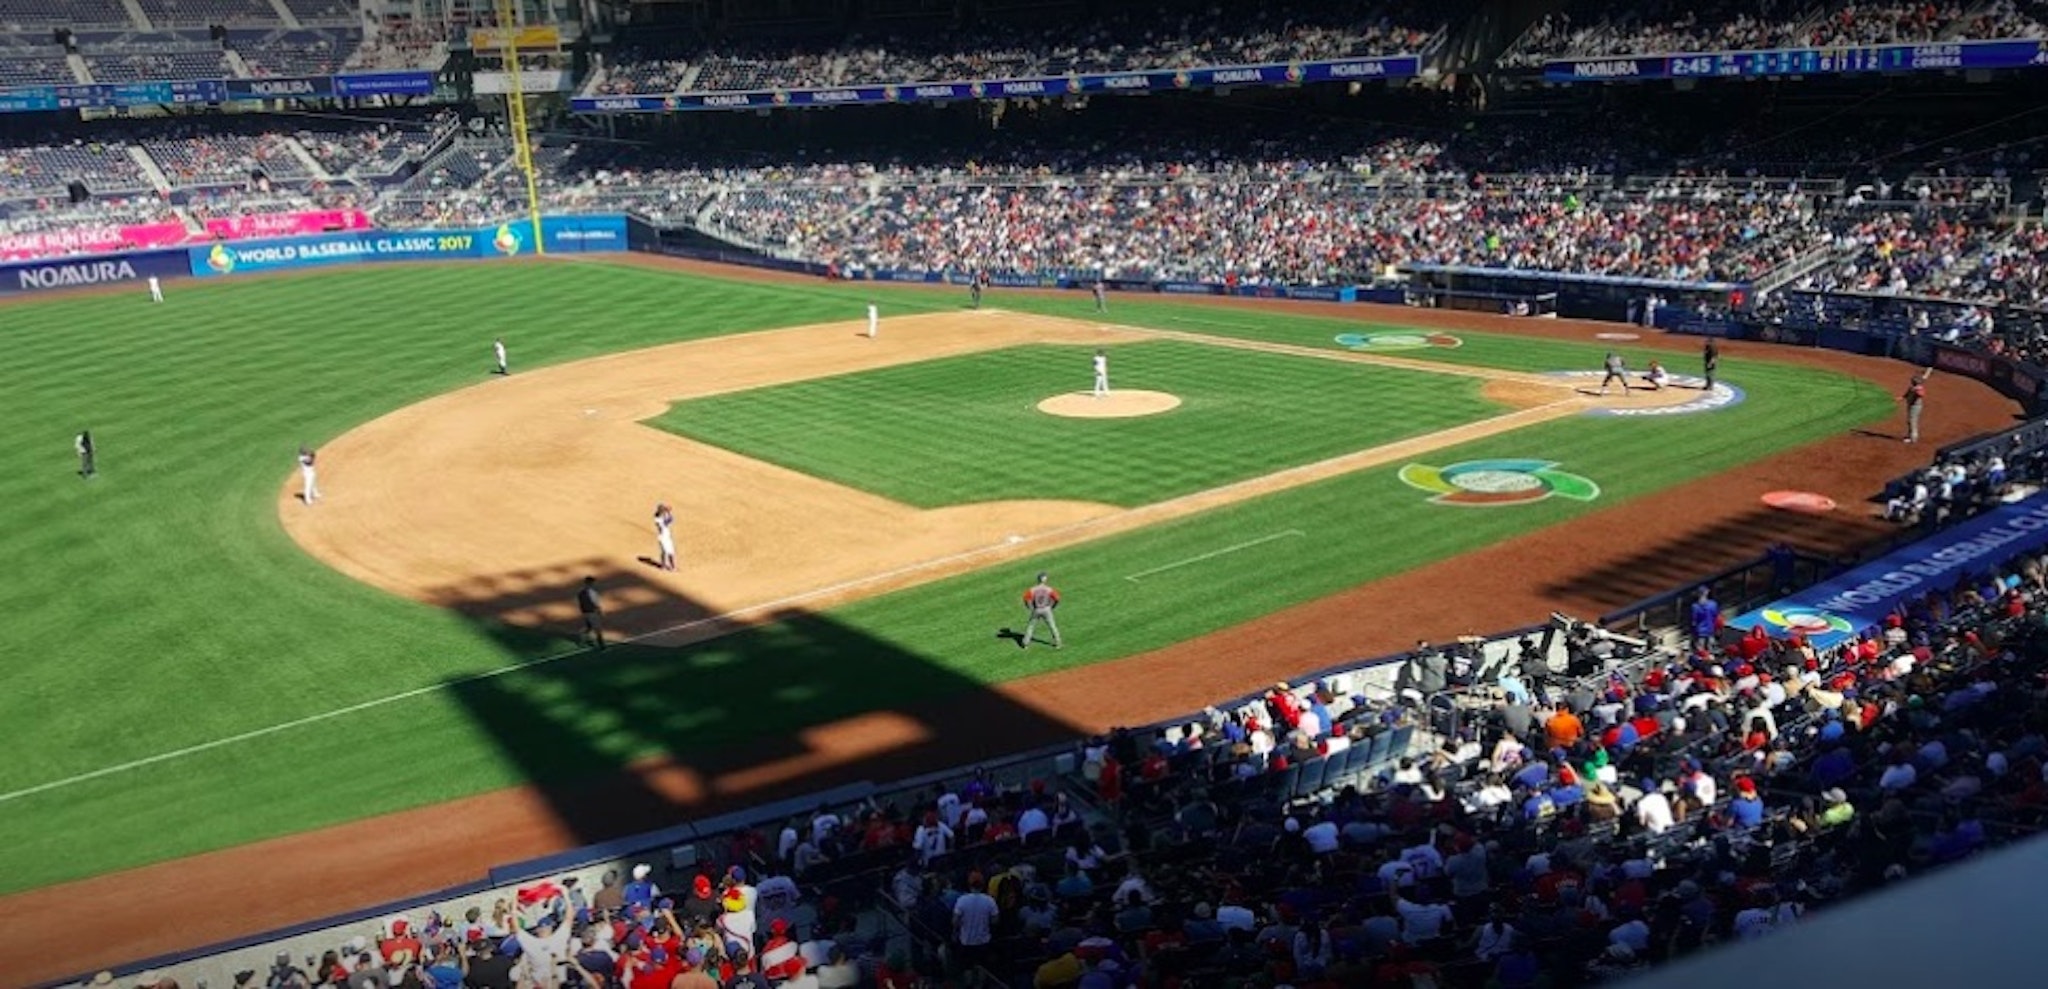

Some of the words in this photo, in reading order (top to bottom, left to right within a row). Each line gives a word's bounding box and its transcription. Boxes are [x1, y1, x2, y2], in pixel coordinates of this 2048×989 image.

[1912, 46, 1961, 56] CARLOS
[1330, 62, 1384, 76] NOMURA
[1573, 61, 1639, 77] NOMURA
[1672, 58, 1711, 75] 2:45
[1820, 58, 1831, 70] 6
[1213, 70, 1262, 83] NOMURA
[250, 80, 314, 95] NOMURA
[80, 226, 123, 245] DECK
[238, 246, 296, 264] WORLD
[301, 240, 375, 259] BASEBALL
[377, 238, 435, 253] CLASSIC
[438, 235, 472, 250] 2017
[19, 260, 136, 290] NOMURA
[1816, 571, 1922, 612] WORLD
[1902, 527, 2028, 576] BASEBALL
